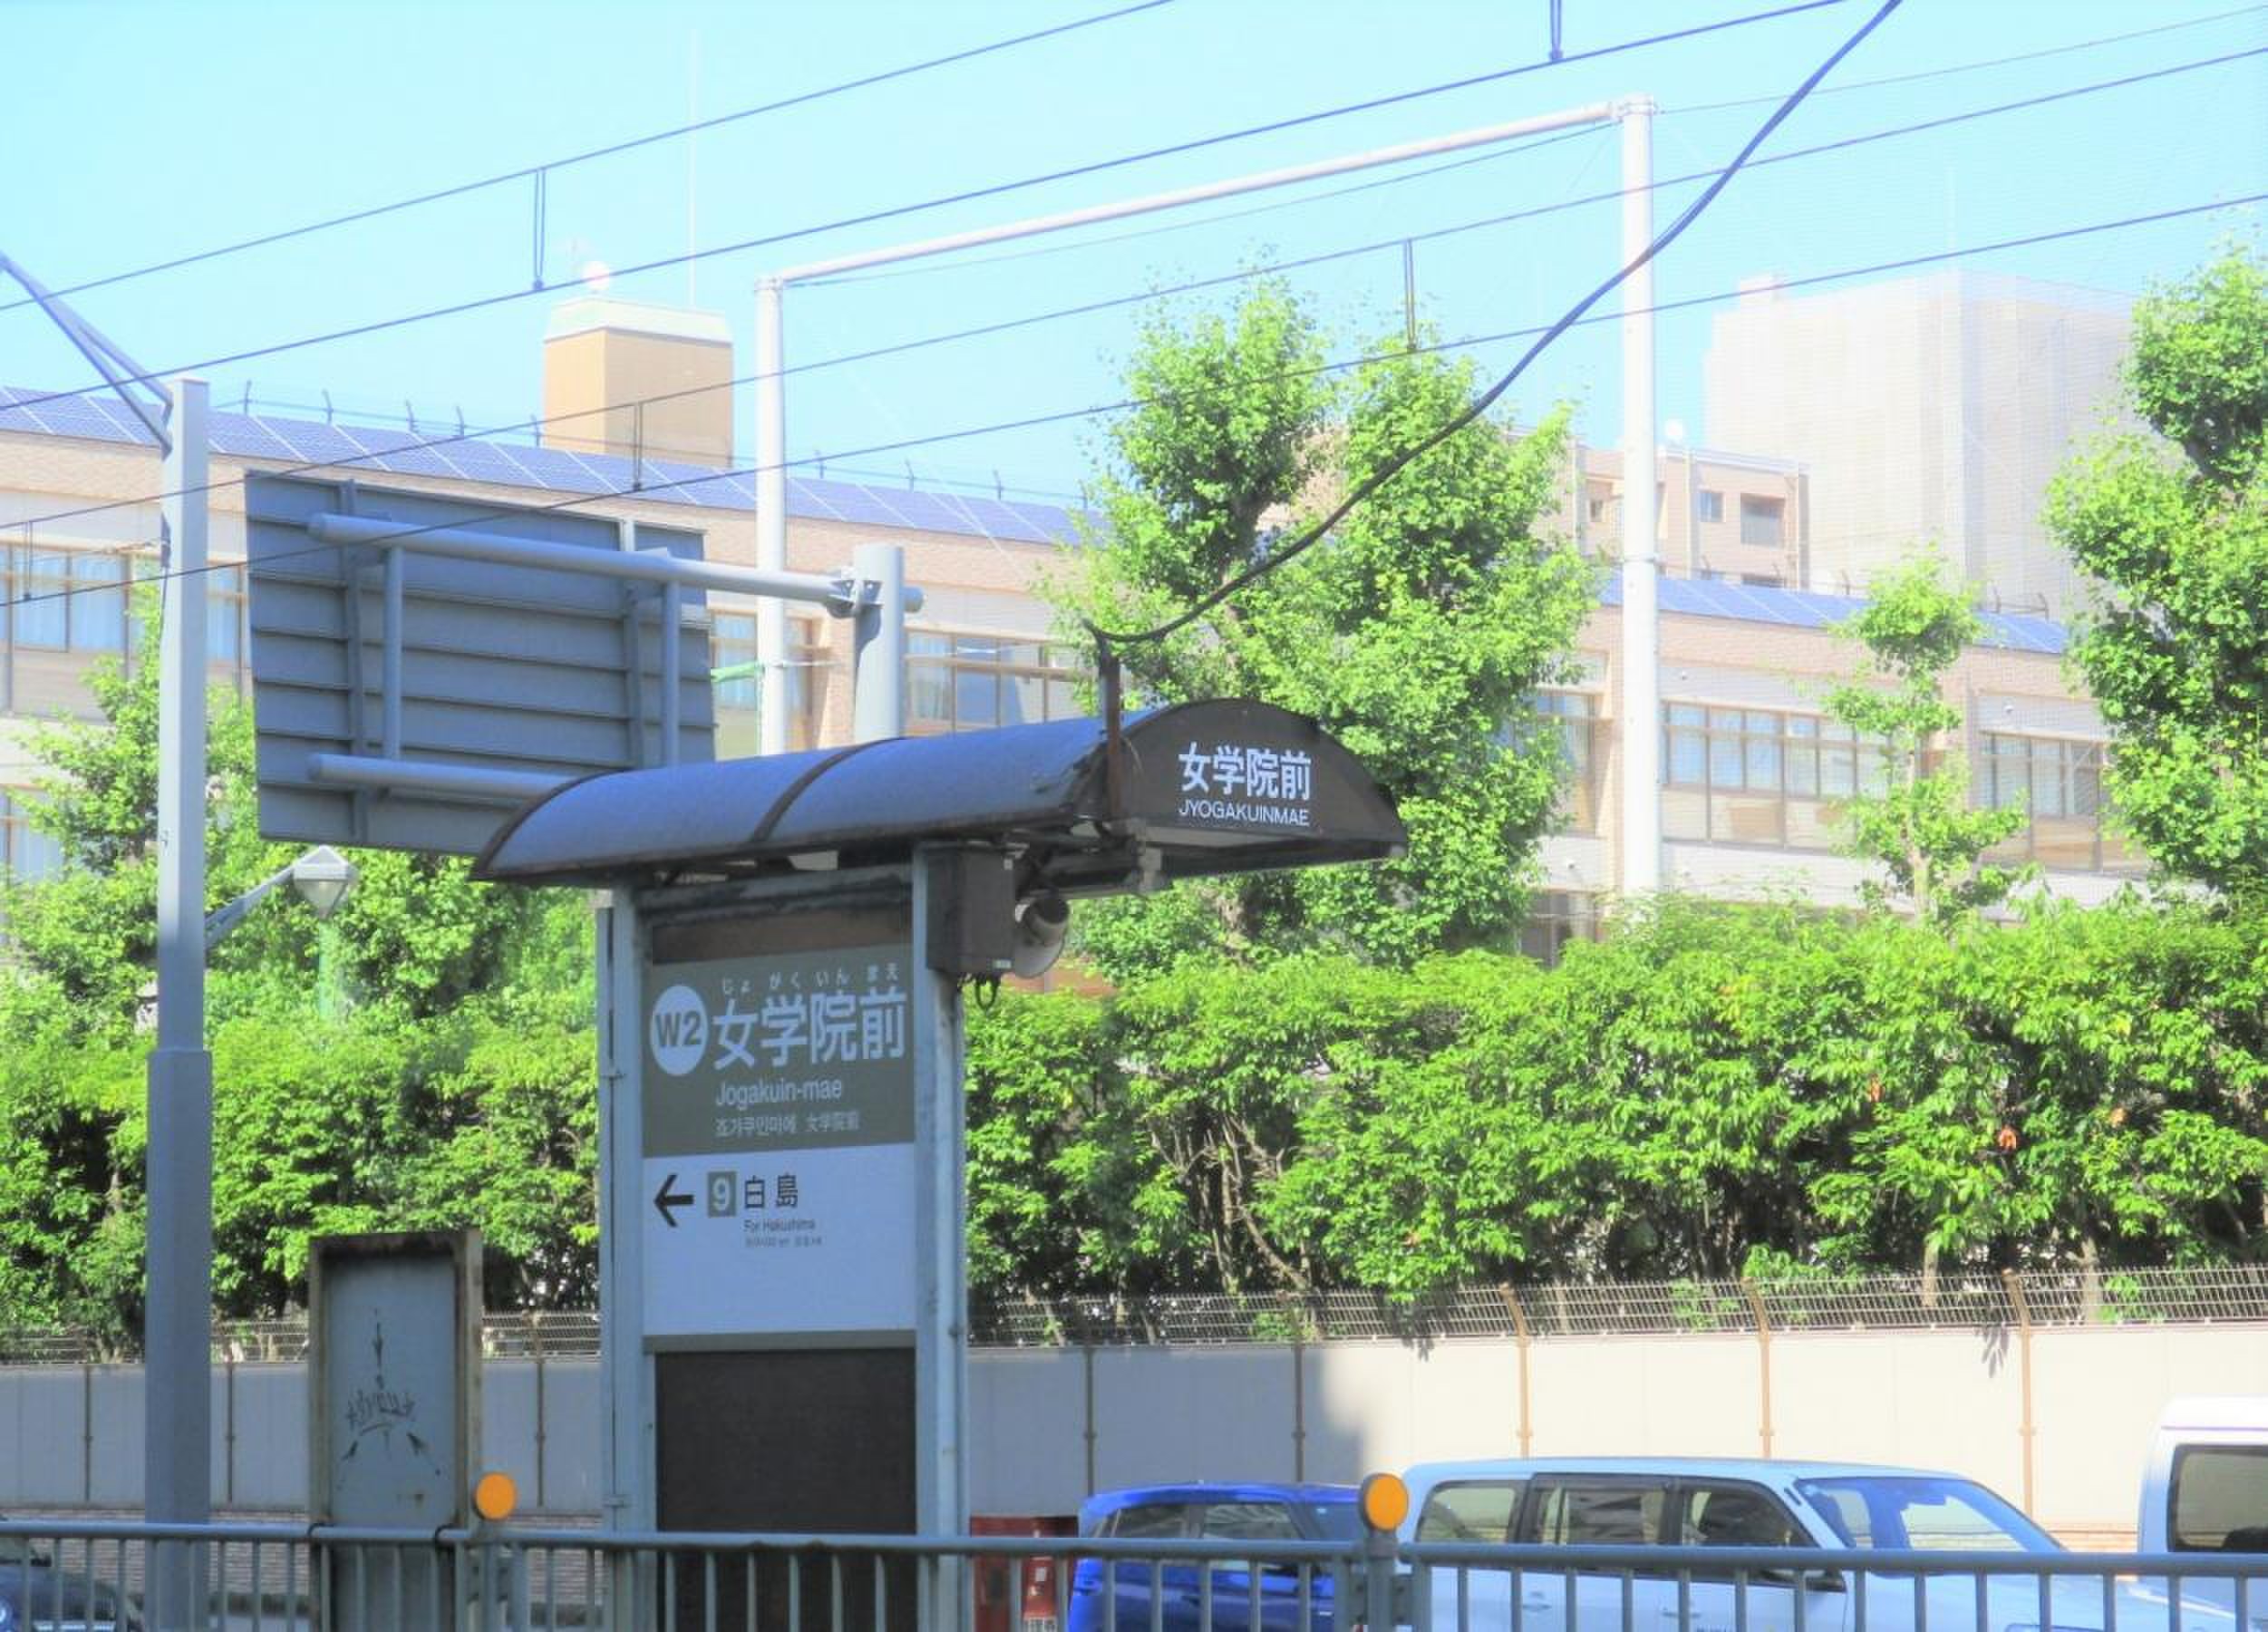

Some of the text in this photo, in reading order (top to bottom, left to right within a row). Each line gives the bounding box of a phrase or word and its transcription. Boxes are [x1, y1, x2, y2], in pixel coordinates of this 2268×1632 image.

[1178, 741, 1311, 800] 女学院前
[1178, 799, 1311, 827] JYOGAKUINMAE
[654, 1011, 703, 1047] W2
[713, 986, 906, 1070] 女学院前
[714, 1077, 843, 1112] Jogakuin-mae
[712, 1178, 732, 1212] 9
[745, 1172, 798, 1209] 白島
